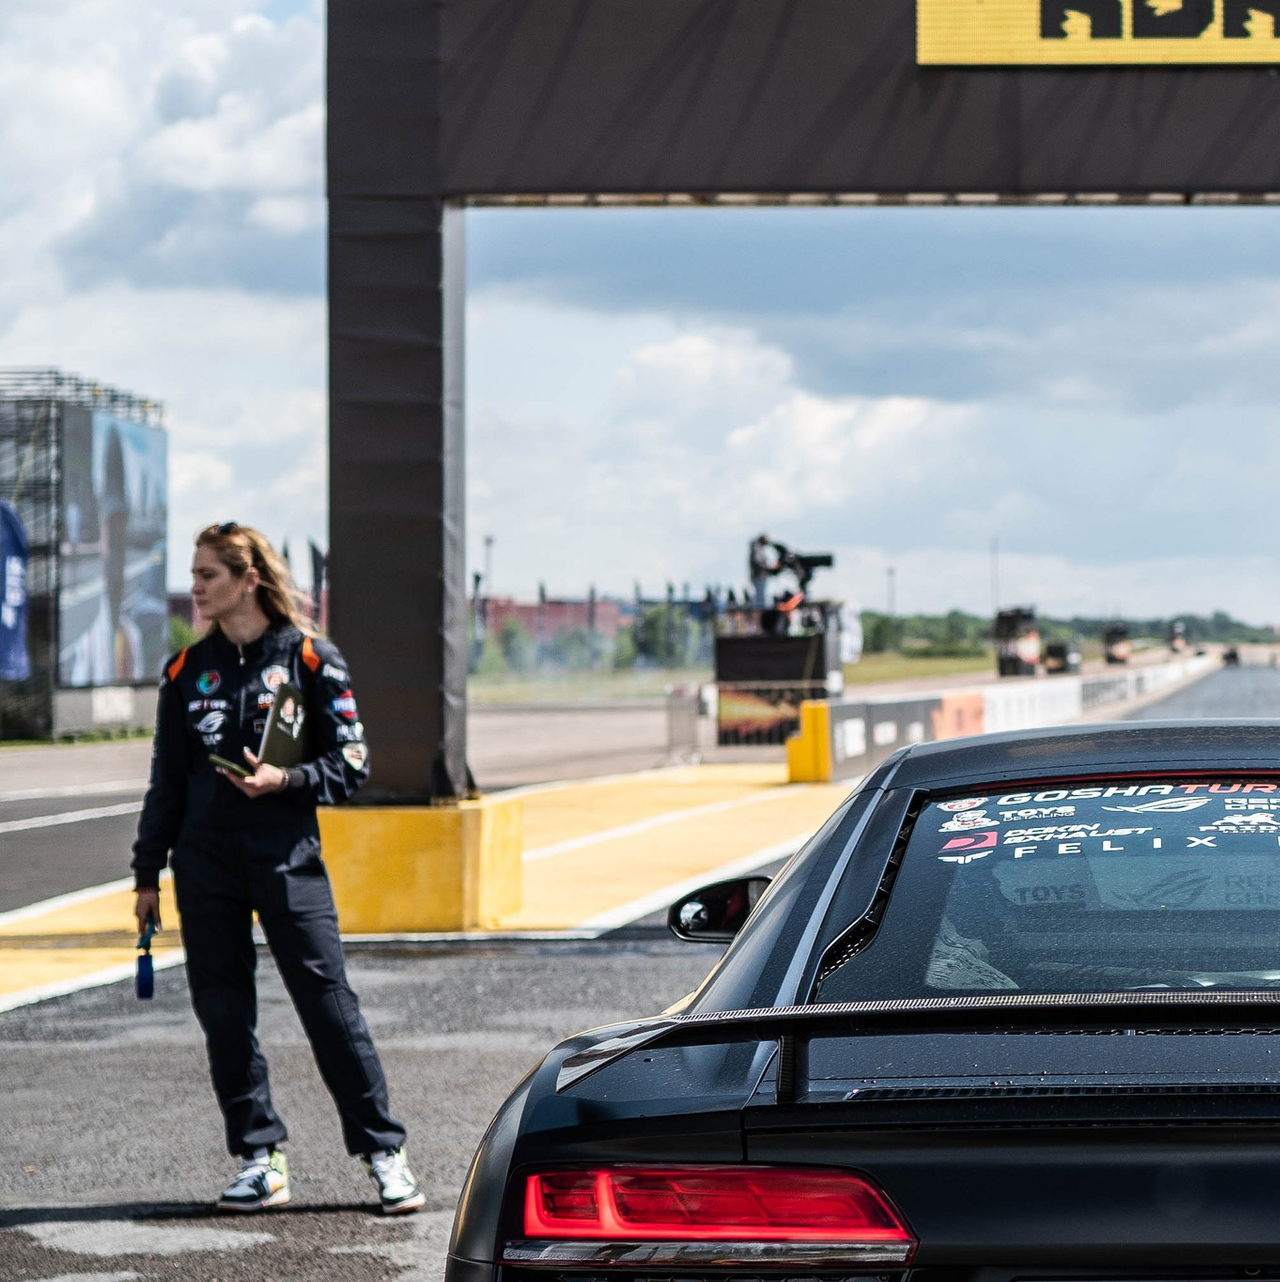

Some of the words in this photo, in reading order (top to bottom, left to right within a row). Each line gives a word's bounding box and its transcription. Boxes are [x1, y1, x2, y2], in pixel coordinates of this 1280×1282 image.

[999, 805, 1076, 819] TOYS
[1003, 827, 1154, 845] EXHAUST
[1014, 836, 1218, 858] FELIX
